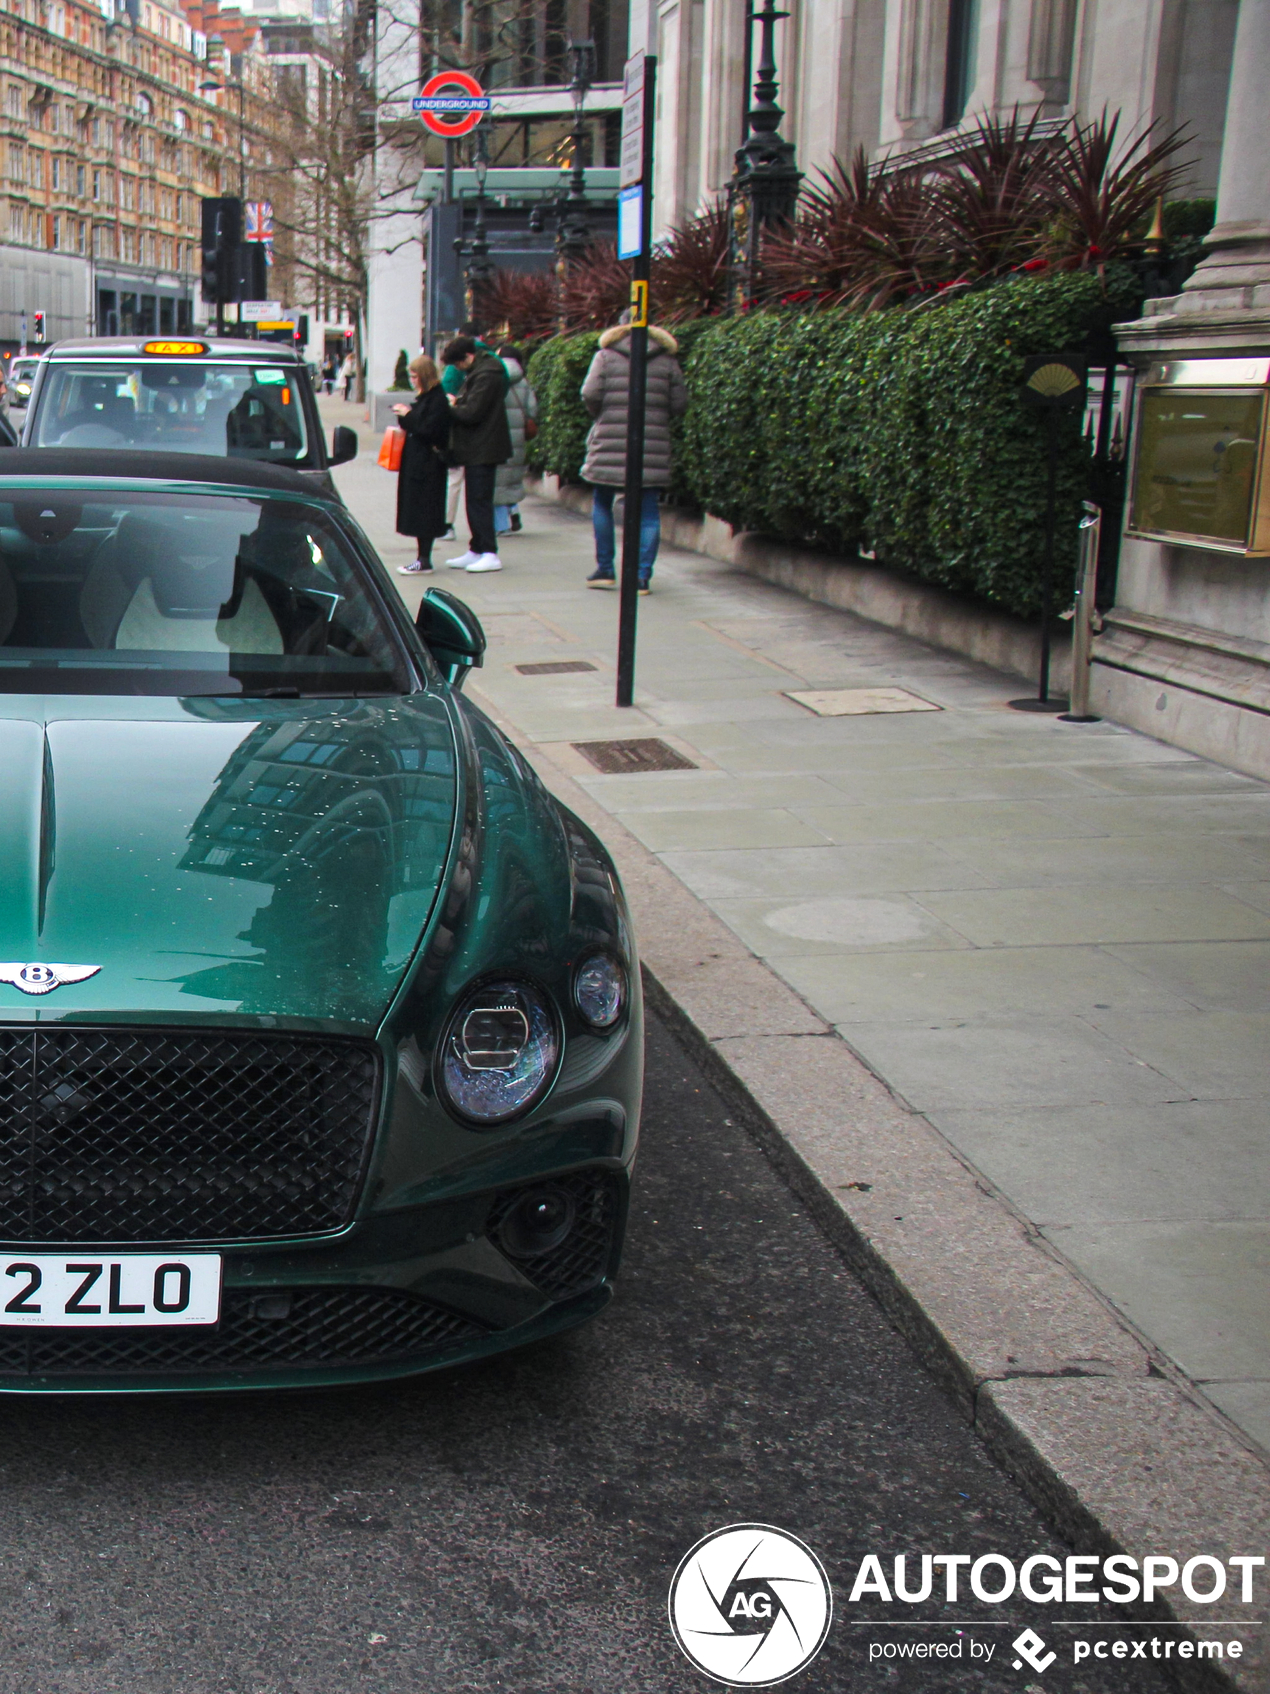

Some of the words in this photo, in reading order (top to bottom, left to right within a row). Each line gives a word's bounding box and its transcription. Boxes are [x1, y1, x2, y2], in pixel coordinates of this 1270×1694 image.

[415, 99, 488, 110] UNDERGROUND
[152, 343, 199, 352] TAXI
[25, 964, 47, 983] B
[65, 1262, 192, 1314] ZLO
